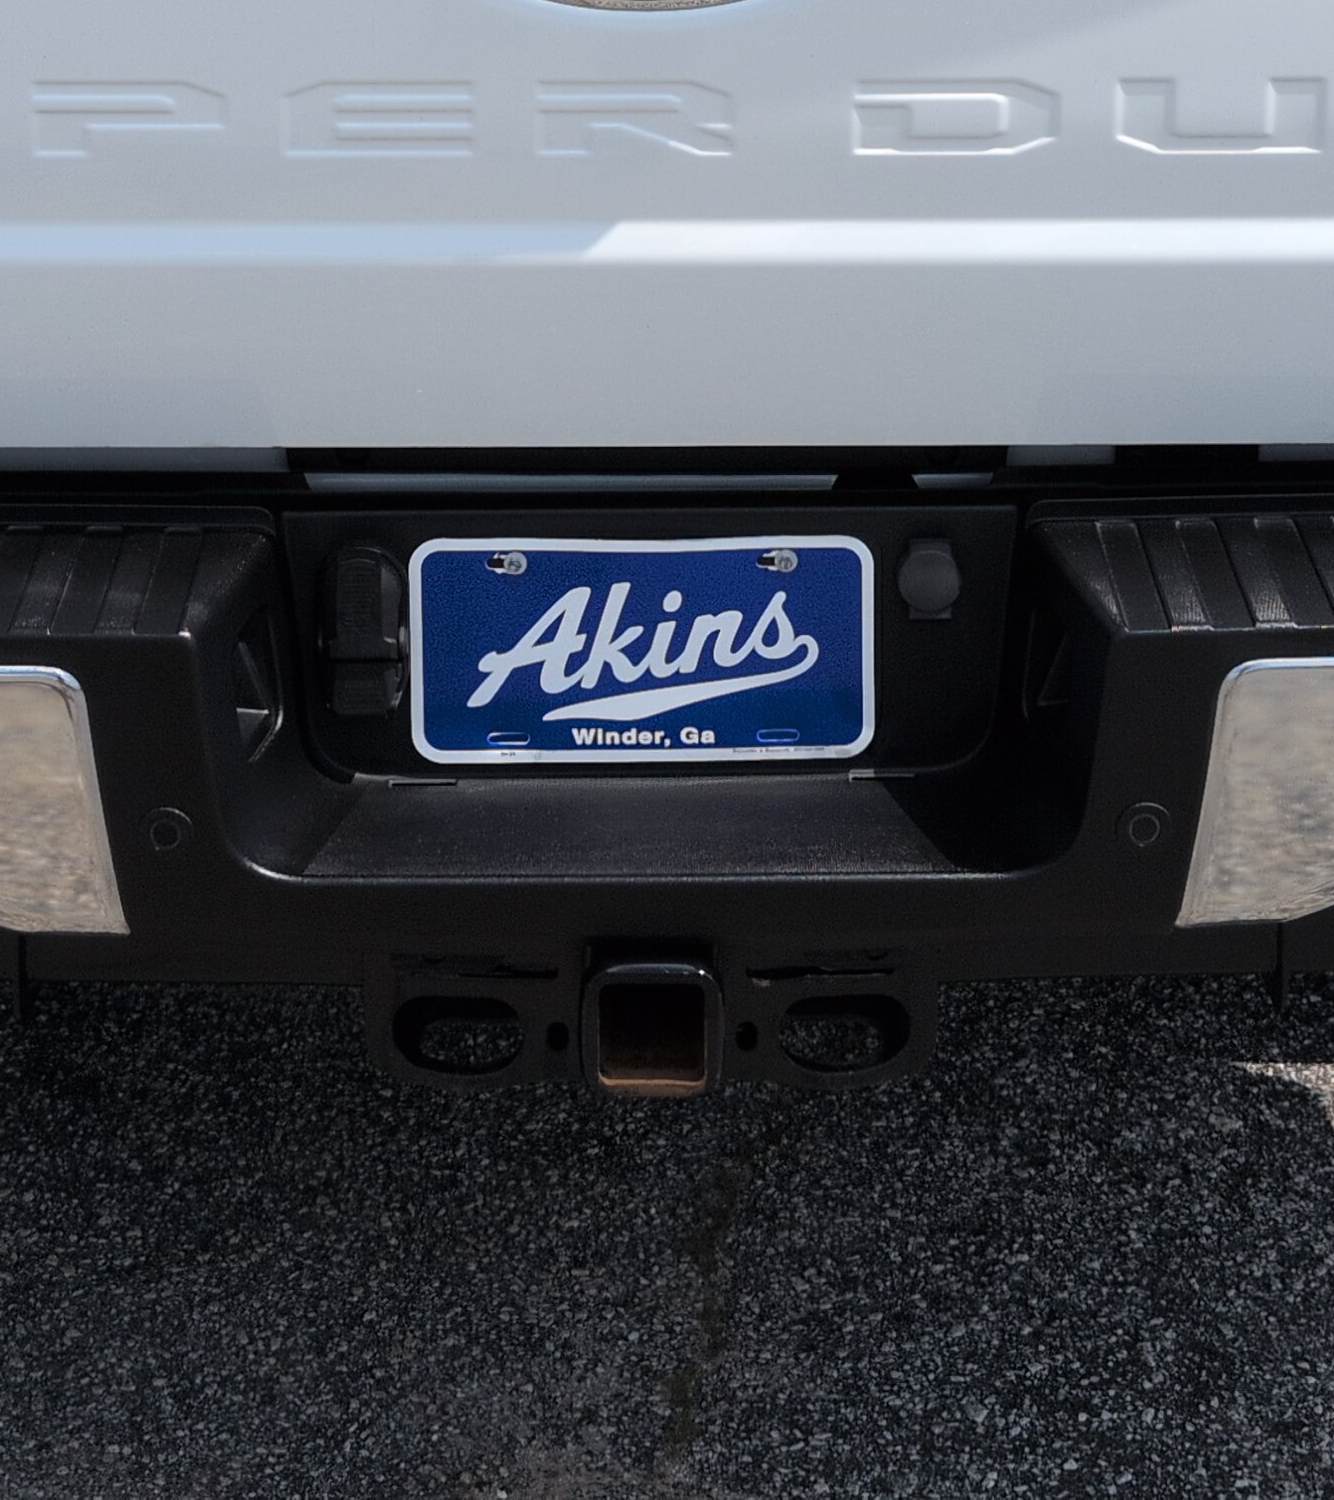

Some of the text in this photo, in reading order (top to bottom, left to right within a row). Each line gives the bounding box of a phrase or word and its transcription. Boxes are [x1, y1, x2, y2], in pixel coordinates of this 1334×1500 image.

[467, 582, 819, 721] Akins
[571, 726, 715, 748] Winder, Ga
